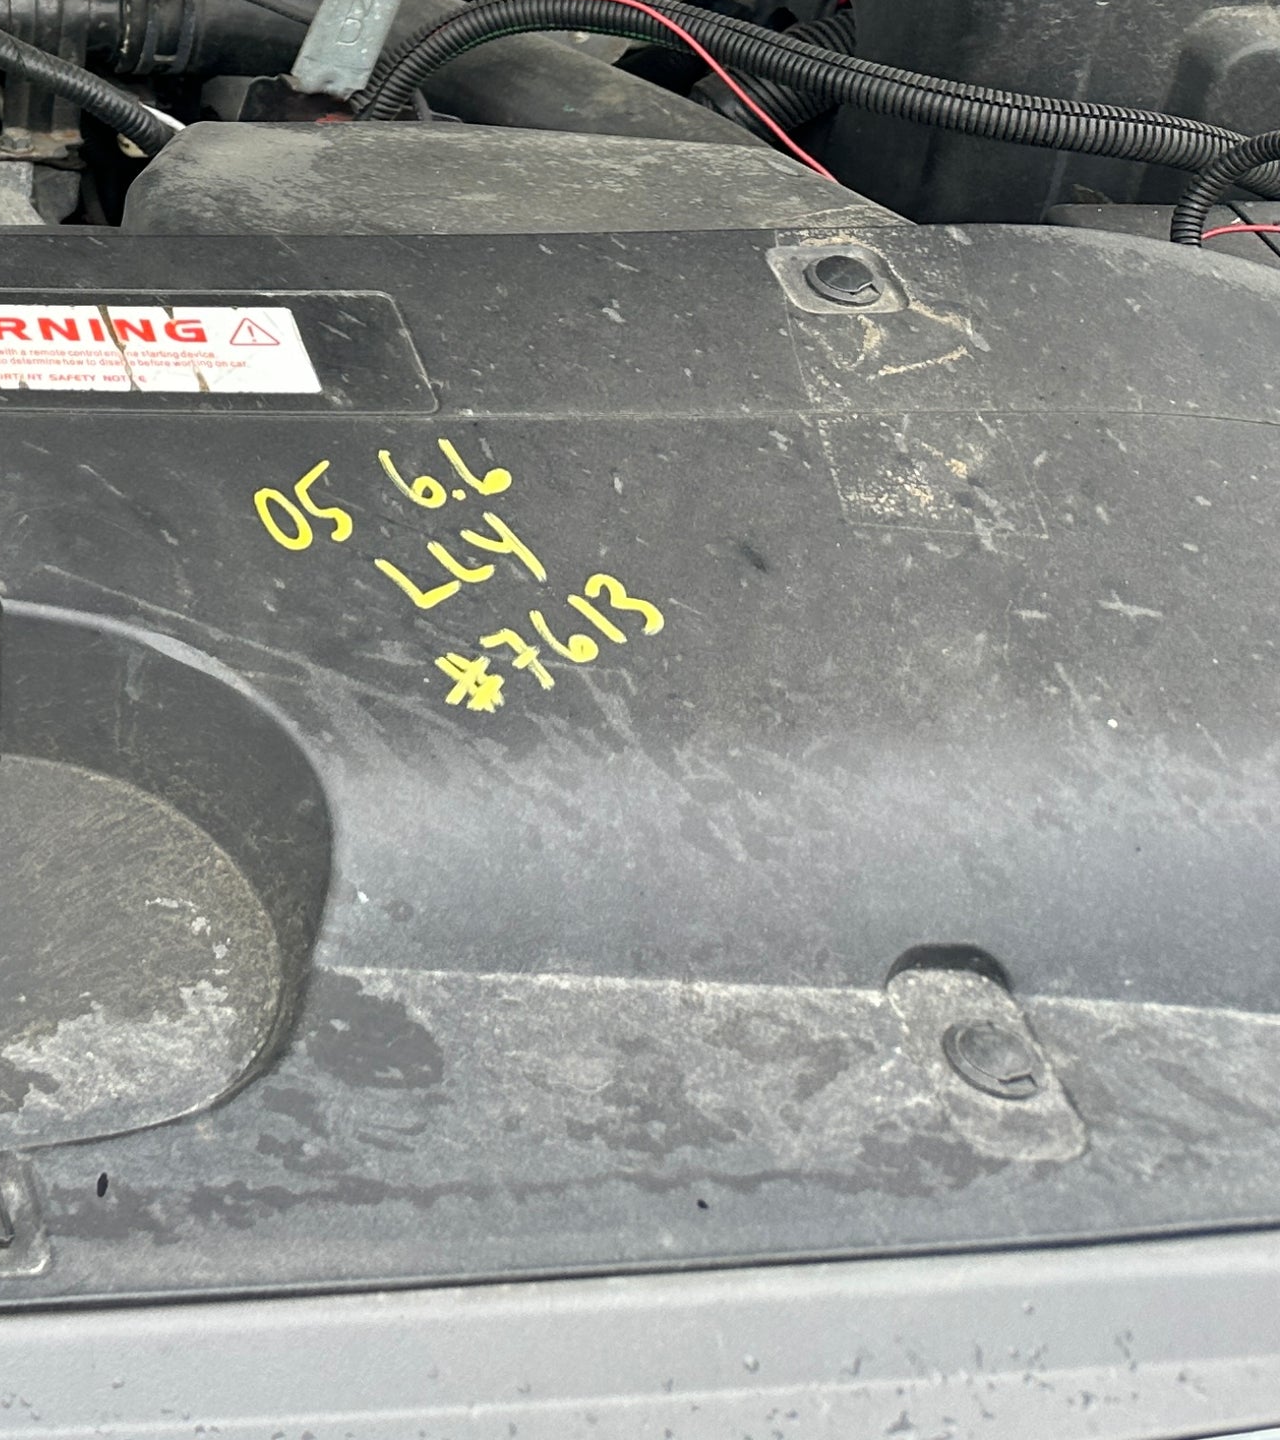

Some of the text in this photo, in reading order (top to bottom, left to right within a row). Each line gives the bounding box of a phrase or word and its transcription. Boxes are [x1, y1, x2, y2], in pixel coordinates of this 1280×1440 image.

[29, 348, 67, 357] remote
[68, 348, 102, 358] control
[49, 373, 96, 382] SAFETY
[253, 438, 513, 550] 05 6.6
[375, 512, 546, 609] LLY
[435, 573, 665, 713] #7613
